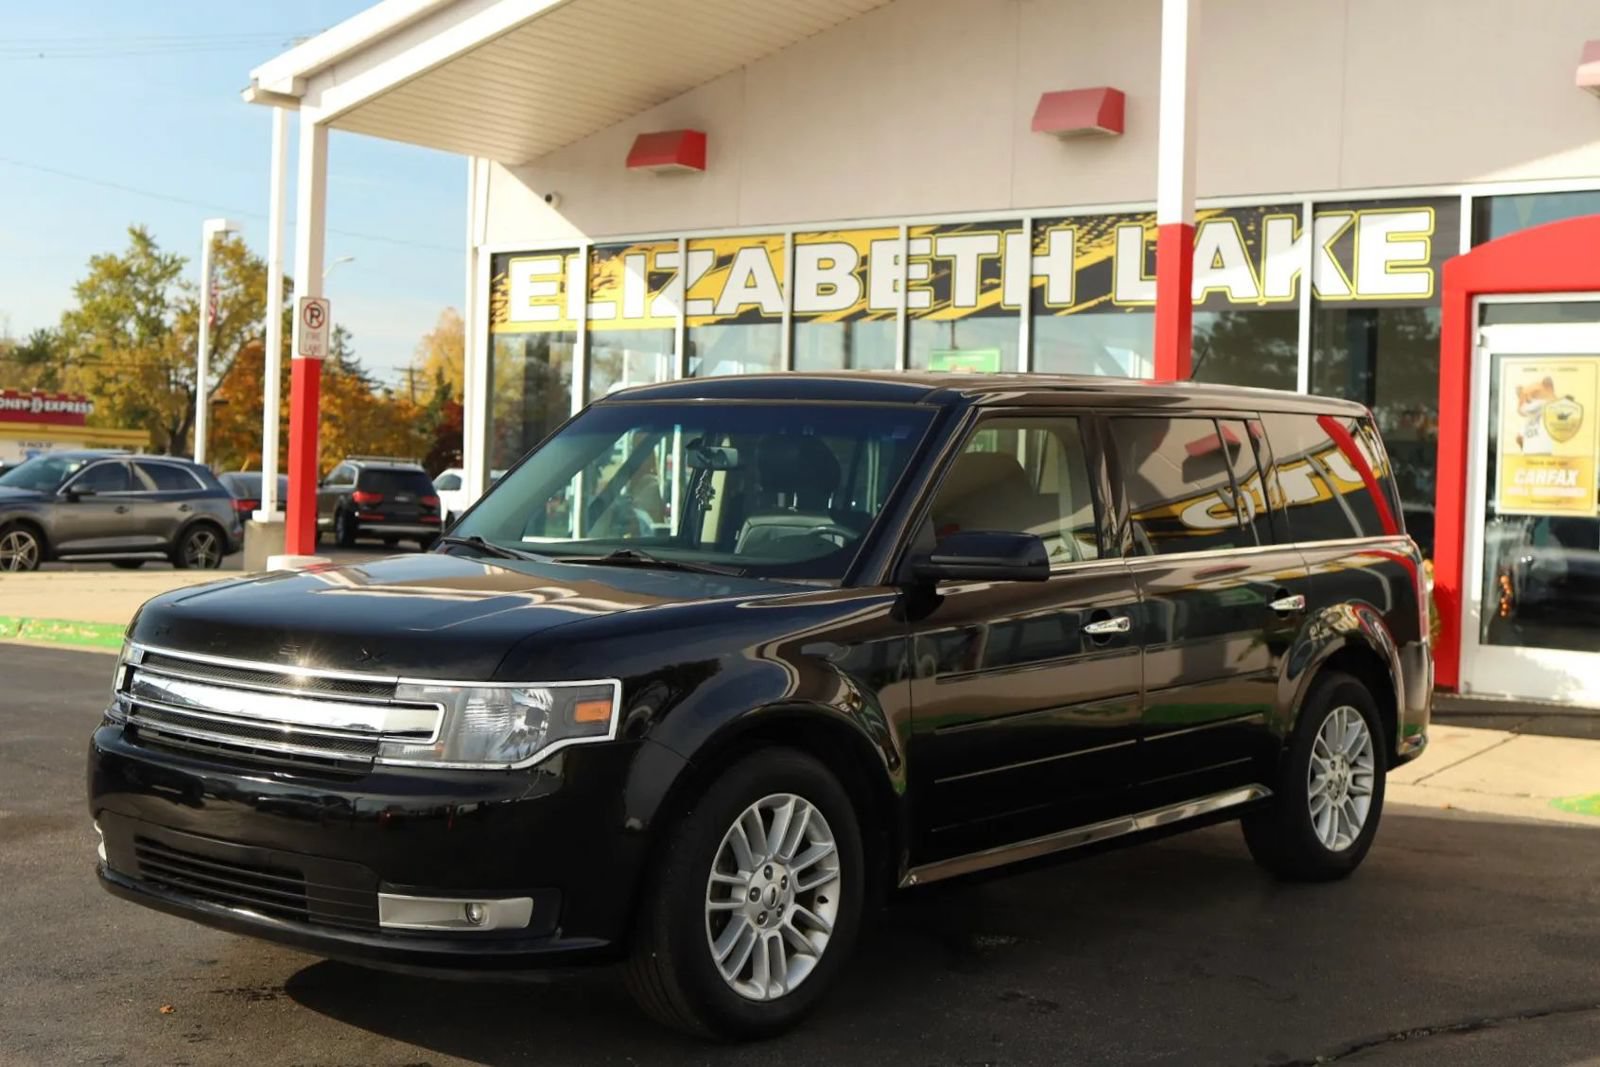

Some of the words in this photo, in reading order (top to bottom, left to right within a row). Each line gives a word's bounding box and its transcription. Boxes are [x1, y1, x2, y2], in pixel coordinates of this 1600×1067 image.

[509, 226, 1076, 322] ELIZABETH
[1112, 207, 1435, 306] LAKE
[44, 400, 94, 415] EXPRESS
[1515, 467, 1578, 486] CARFAX
